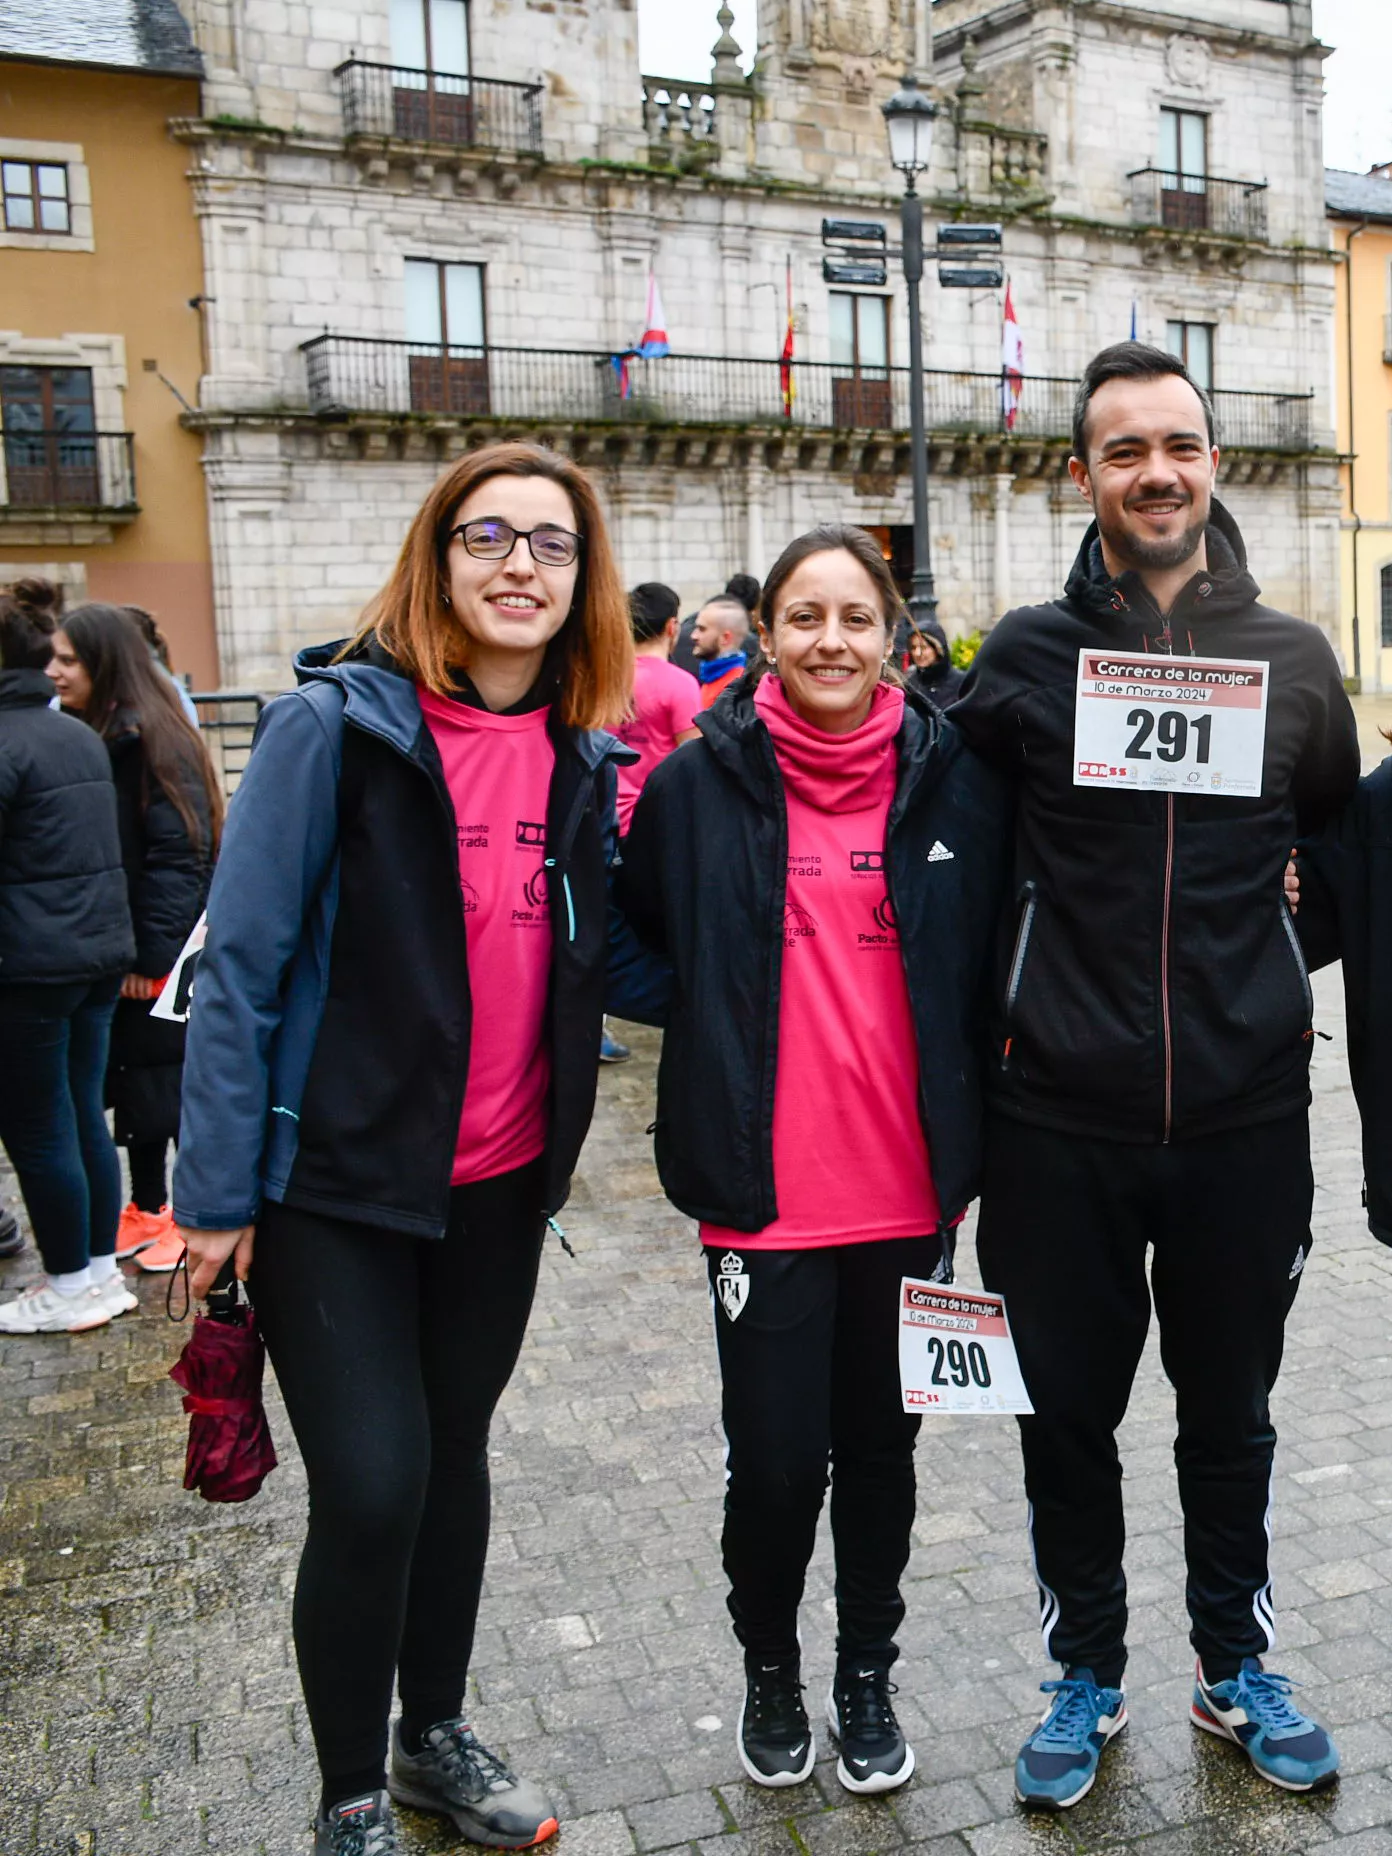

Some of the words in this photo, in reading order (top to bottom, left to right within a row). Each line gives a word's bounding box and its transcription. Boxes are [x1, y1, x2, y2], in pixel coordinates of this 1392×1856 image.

[1097, 661, 1161, 680] Carrera
[1165, 667, 1188, 682] de
[1188, 669, 1202, 682] la
[1205, 673, 1254, 689] mujer
[1094, 681, 1105, 693] 10
[1108, 684, 1123, 694] de
[1126, 684, 1173, 699] Marzo
[1175, 688, 1207, 701] 2024
[1124, 708, 1213, 765] 291
[459, 836, 489, 848] rada
[786, 856, 822, 865] miento
[787, 866, 823, 877] rrada
[857, 933, 888, 945] Pacto
[910, 1290, 947, 1311] Carrera
[948, 1297, 961, 1311] de
[961, 1299, 970, 1312] la
[970, 1303, 999, 1318] mujer
[917, 1313, 926, 1321] de
[955, 1318, 975, 1330] 2024
[927, 1336, 992, 1388] 290
